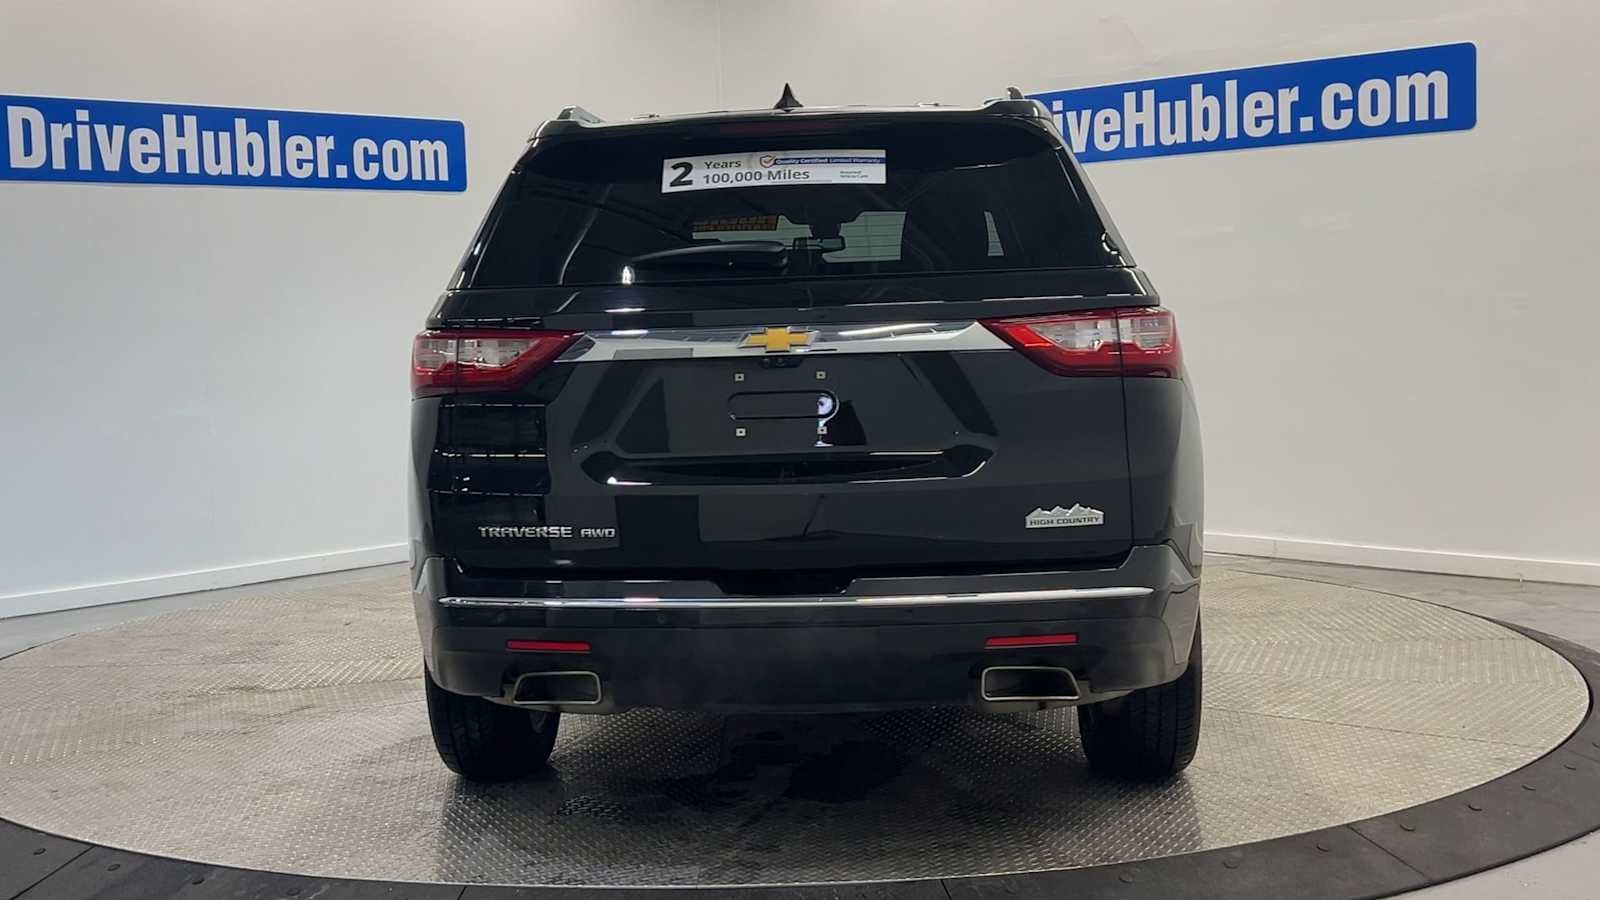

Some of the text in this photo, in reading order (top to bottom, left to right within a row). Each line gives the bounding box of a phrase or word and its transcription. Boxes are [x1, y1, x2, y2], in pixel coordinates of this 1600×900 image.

[1052, 69, 1450, 154] iveHubler.com
[6, 104, 450, 182] DriveHubler.com
[703, 159, 742, 170] Years
[669, 161, 693, 187] 2
[703, 169, 810, 185] 100,000 Miles
[1056, 516, 1099, 525] COUNTRY
[478, 526, 616, 538] TRAVERSE AWD
